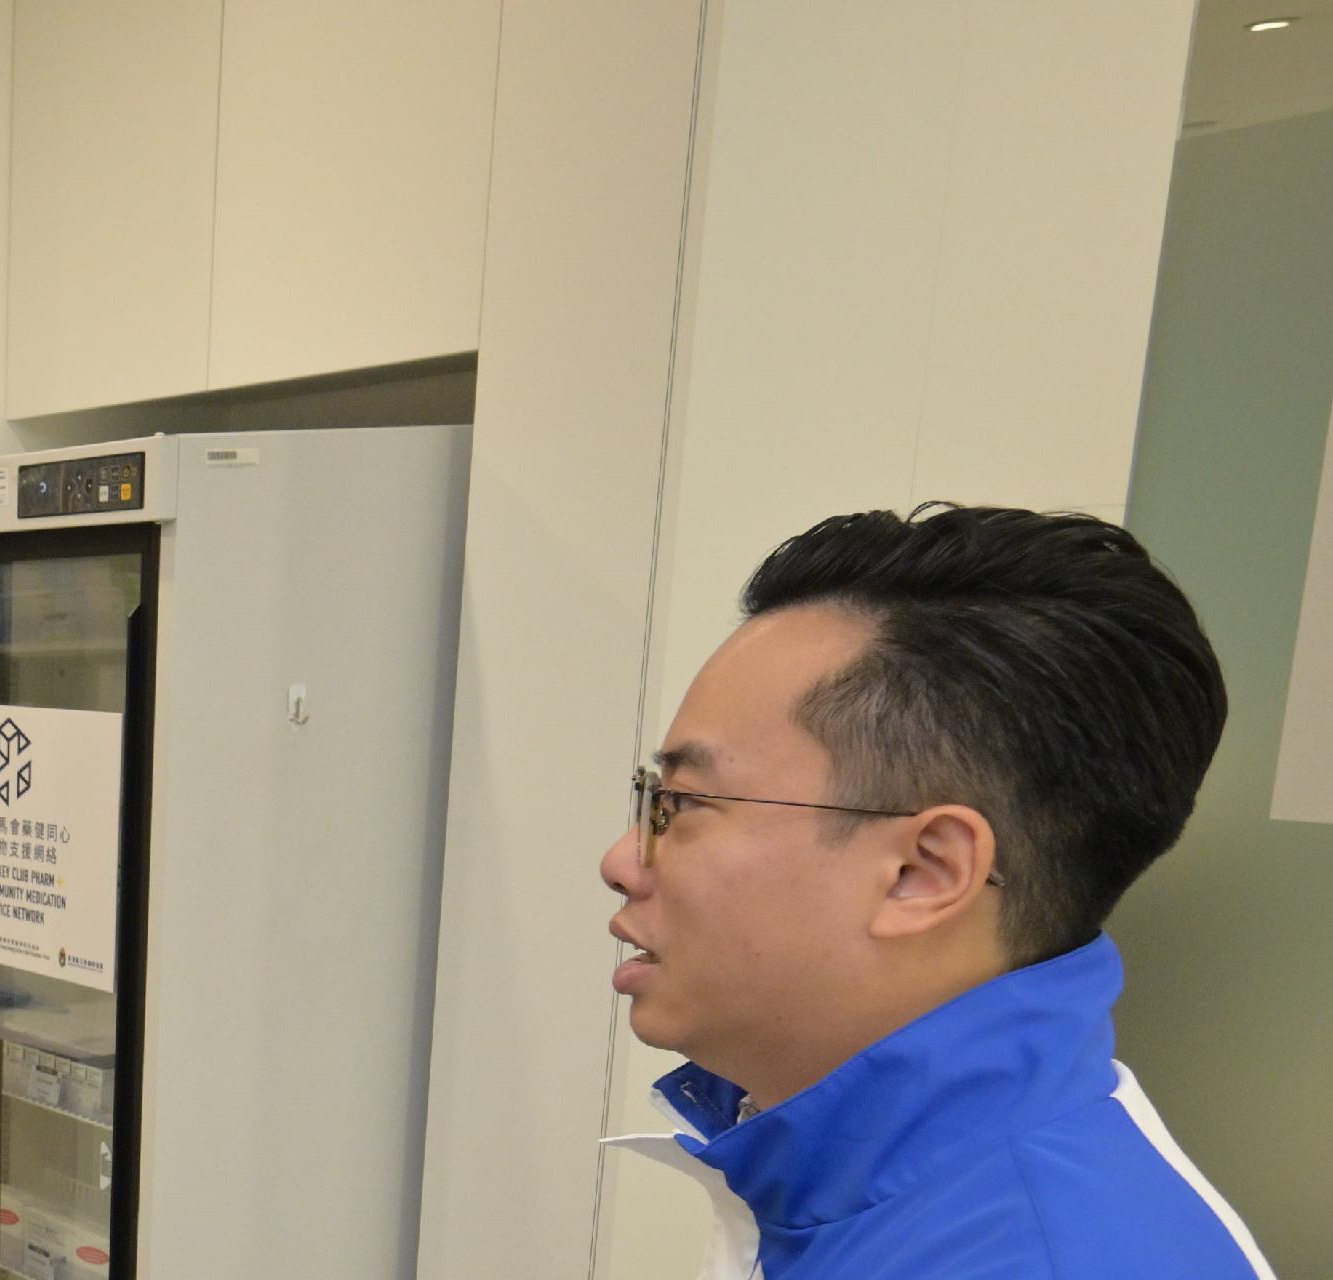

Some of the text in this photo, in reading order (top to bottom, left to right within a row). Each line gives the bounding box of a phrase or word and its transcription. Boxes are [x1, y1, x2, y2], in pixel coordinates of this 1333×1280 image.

[12, 866, 28, 883] CLUB
[31, 869, 55, 887] PHARM
[26, 889, 66, 910] MEDICATION
[13, 906, 45, 925] NETWORK
